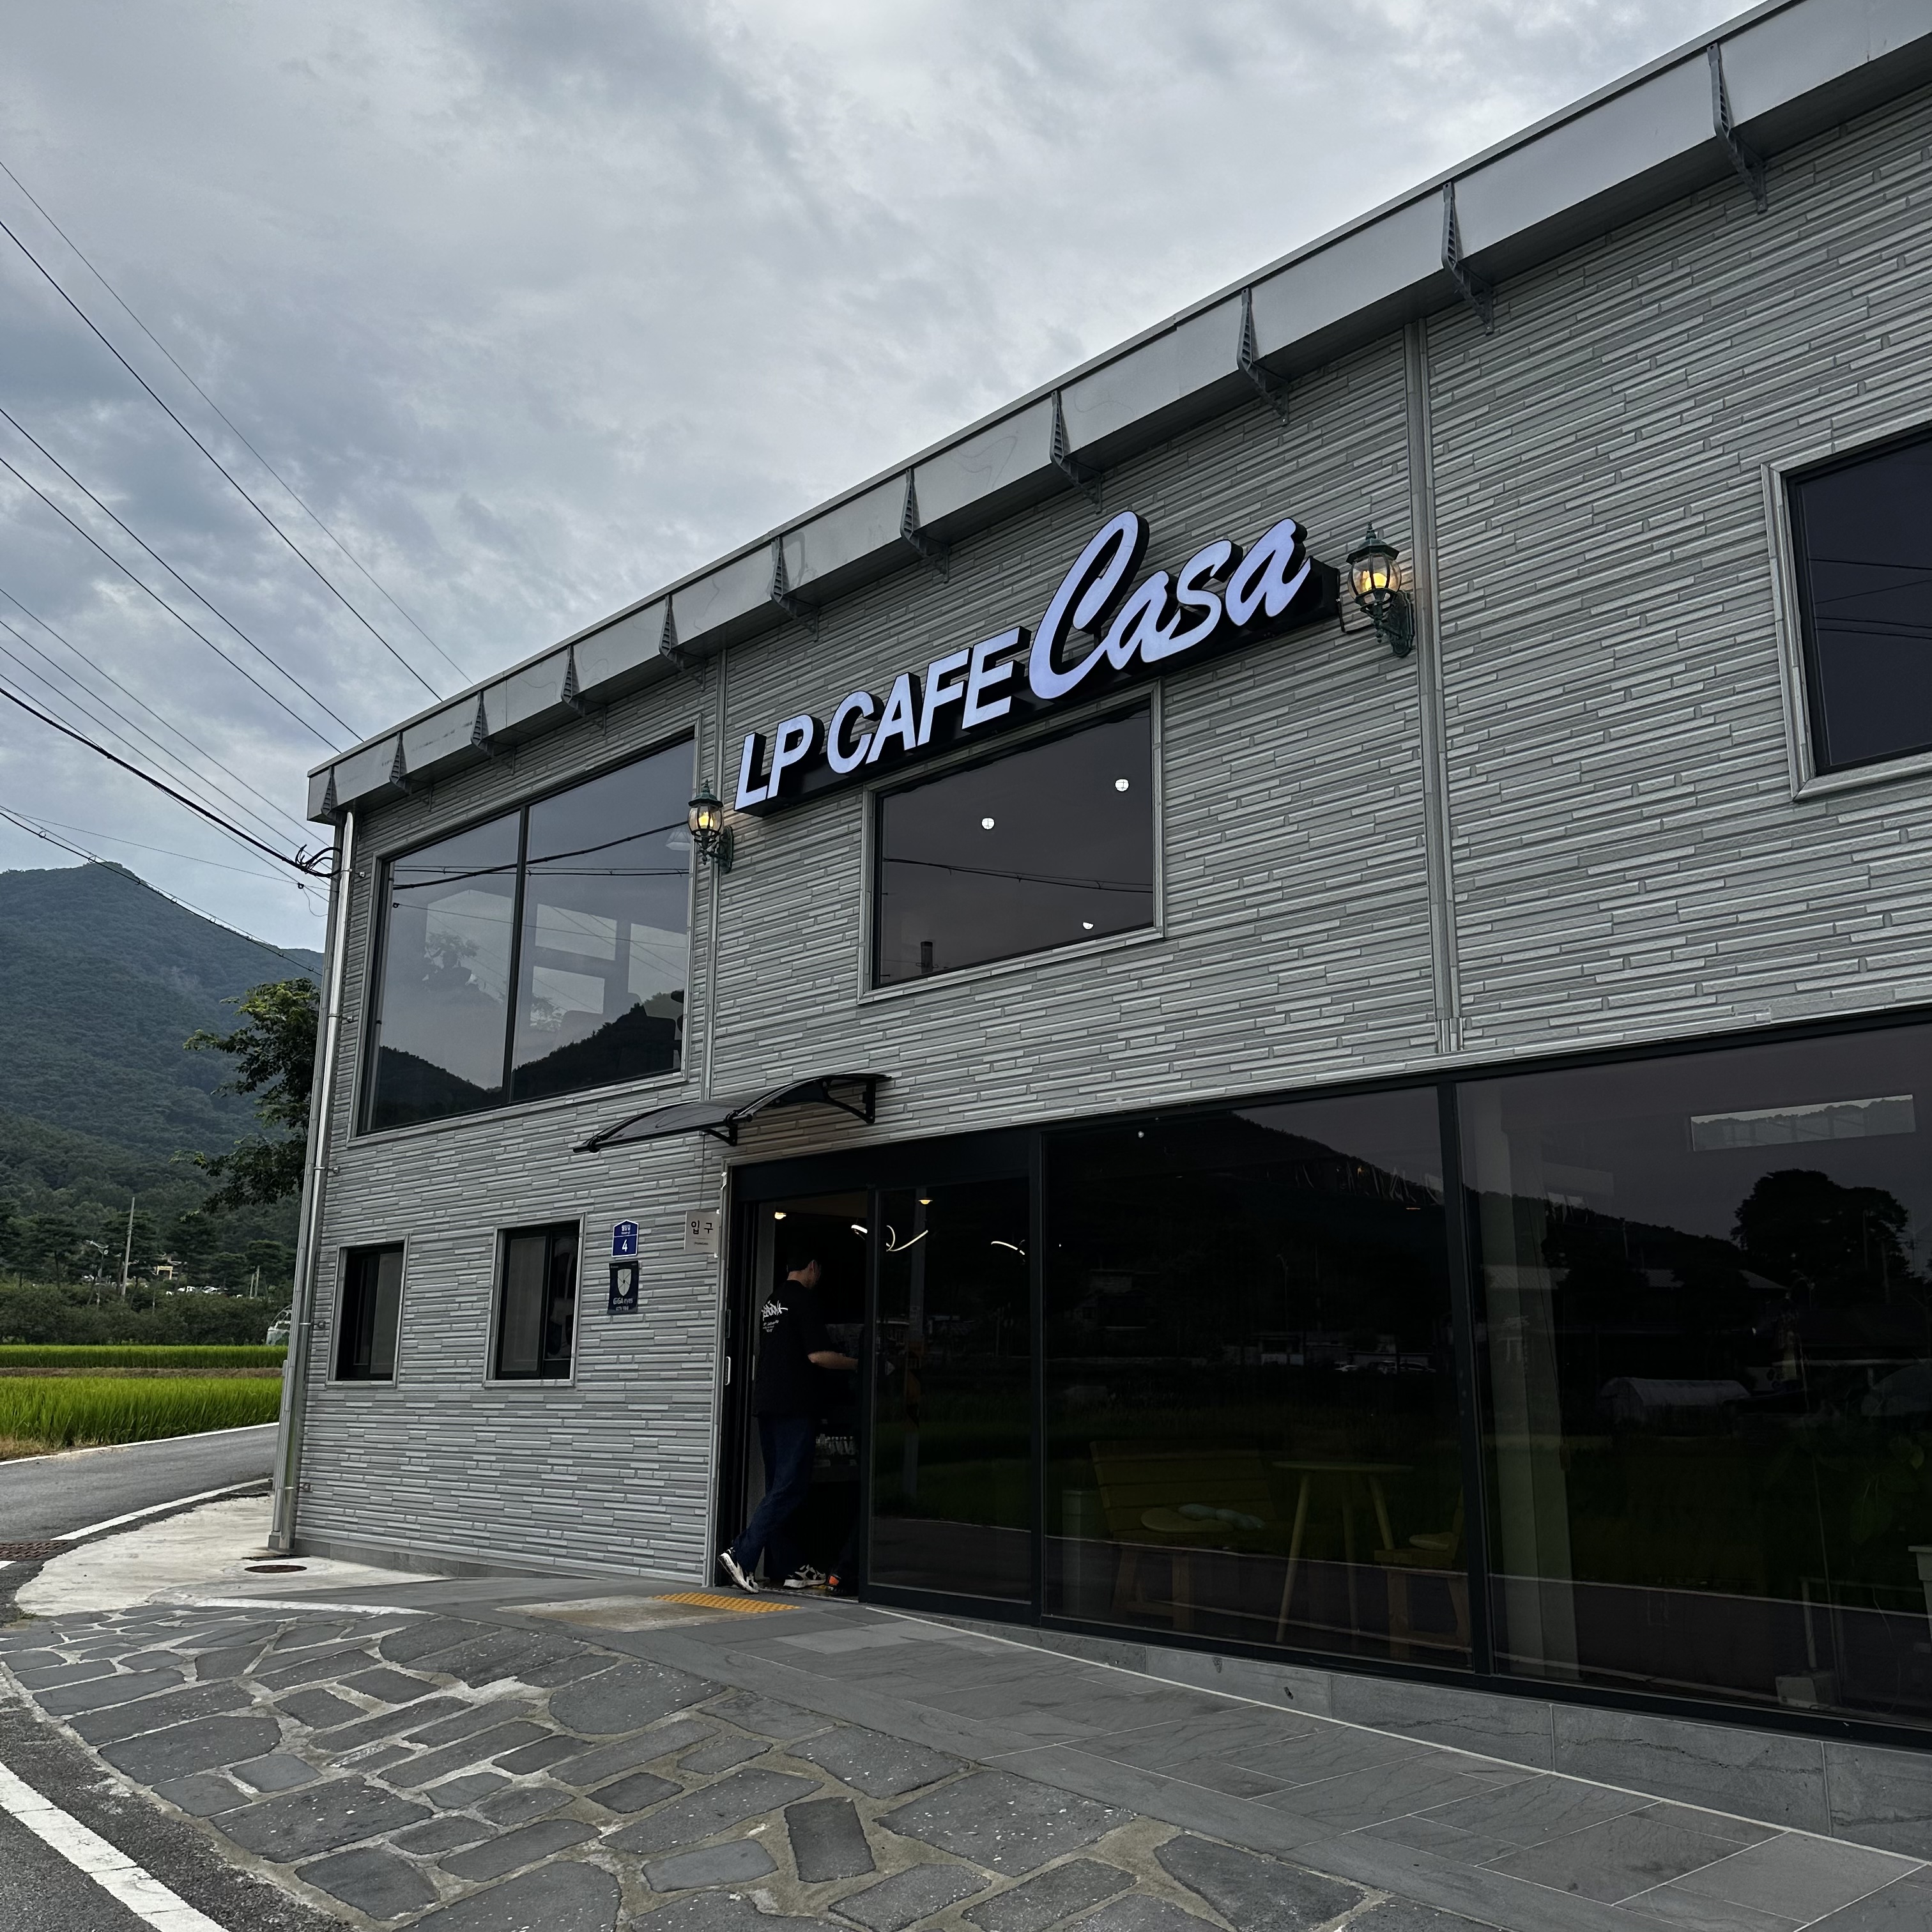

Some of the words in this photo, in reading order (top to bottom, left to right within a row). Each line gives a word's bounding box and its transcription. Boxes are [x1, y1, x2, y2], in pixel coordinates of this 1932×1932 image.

[734, 714, 816, 809] LP
[827, 625, 1023, 774] CAFE
[1029, 510, 1311, 700] Casa
[691, 1220, 714, 1235] 입구
[622, 1239, 628, 1252] 4
